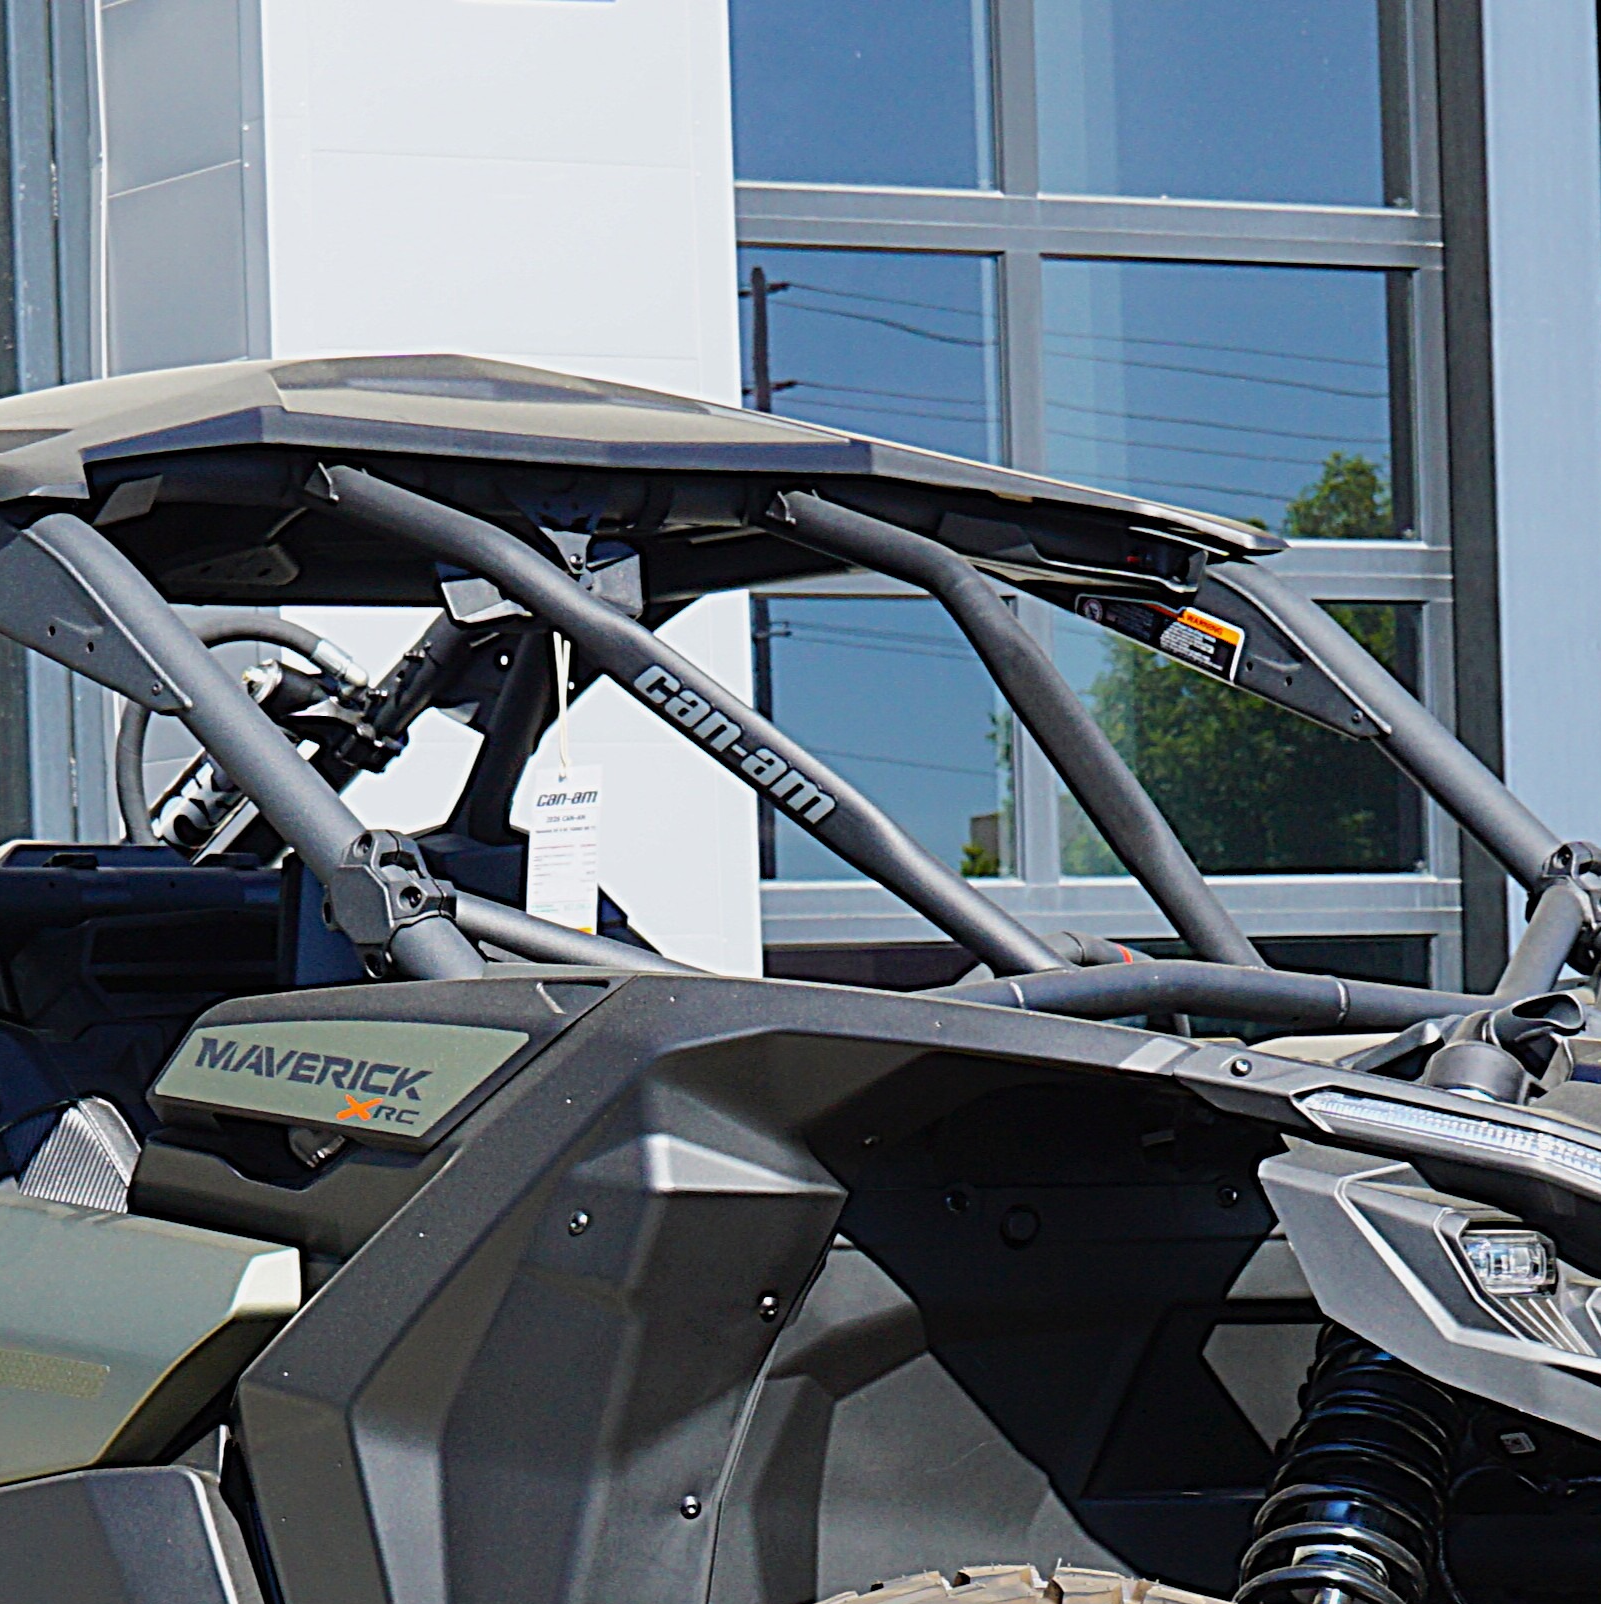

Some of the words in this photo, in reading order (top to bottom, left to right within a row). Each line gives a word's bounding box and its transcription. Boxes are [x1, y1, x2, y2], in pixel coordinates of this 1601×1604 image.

[634, 664, 838, 827] can-am
[535, 789, 599, 808] can-am
[194, 1036, 434, 1101] MAVERICK
[335, 1093, 421, 1126] XRC
